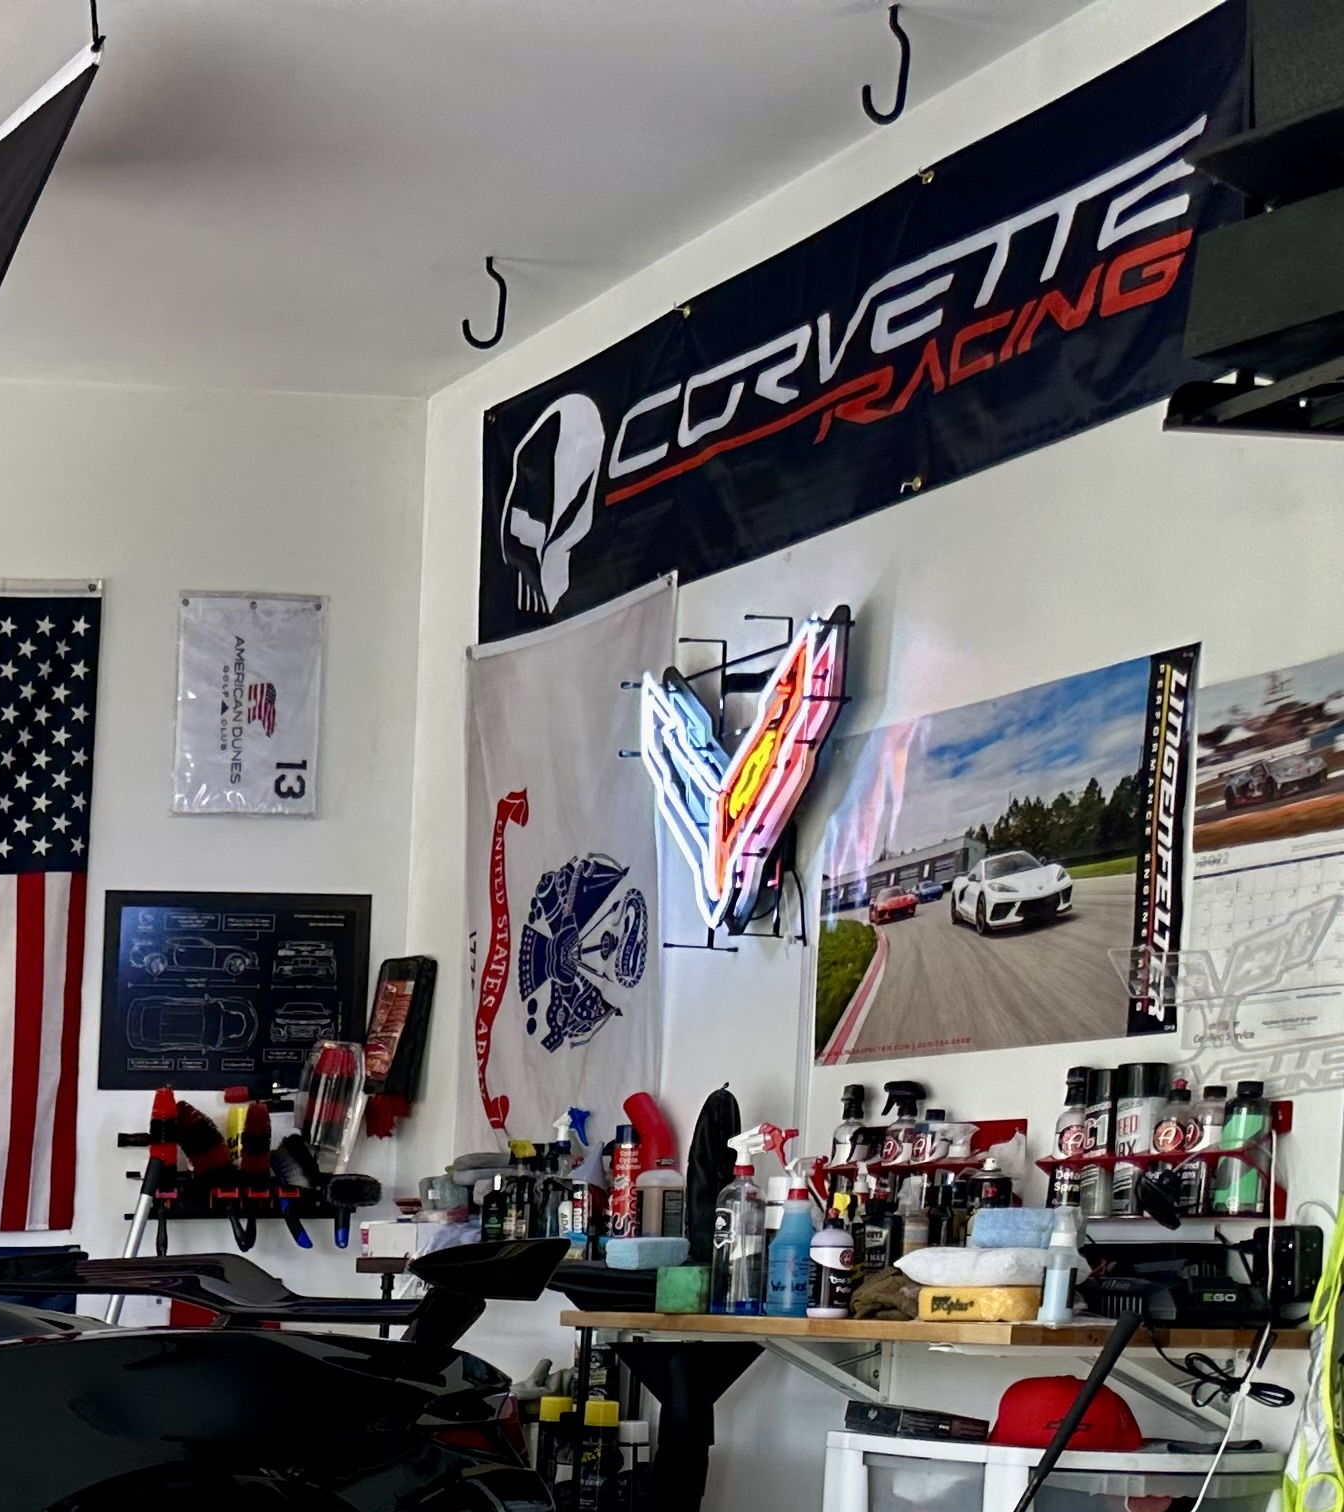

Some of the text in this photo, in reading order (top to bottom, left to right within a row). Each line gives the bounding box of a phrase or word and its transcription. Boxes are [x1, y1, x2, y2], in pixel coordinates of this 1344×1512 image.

[608, 113, 1208, 481] CORVETTE
[219, 718, 229, 752] CLUB
[229, 635, 246, 785] AMERICAN DUNES
[274, 759, 307, 799] 13
[493, 819, 506, 905] UNITED
[1148, 668, 1188, 1023] LINGENFELTER
[480, 914, 509, 1008] STATES
[1202, 1292, 1237, 1303] EGO
